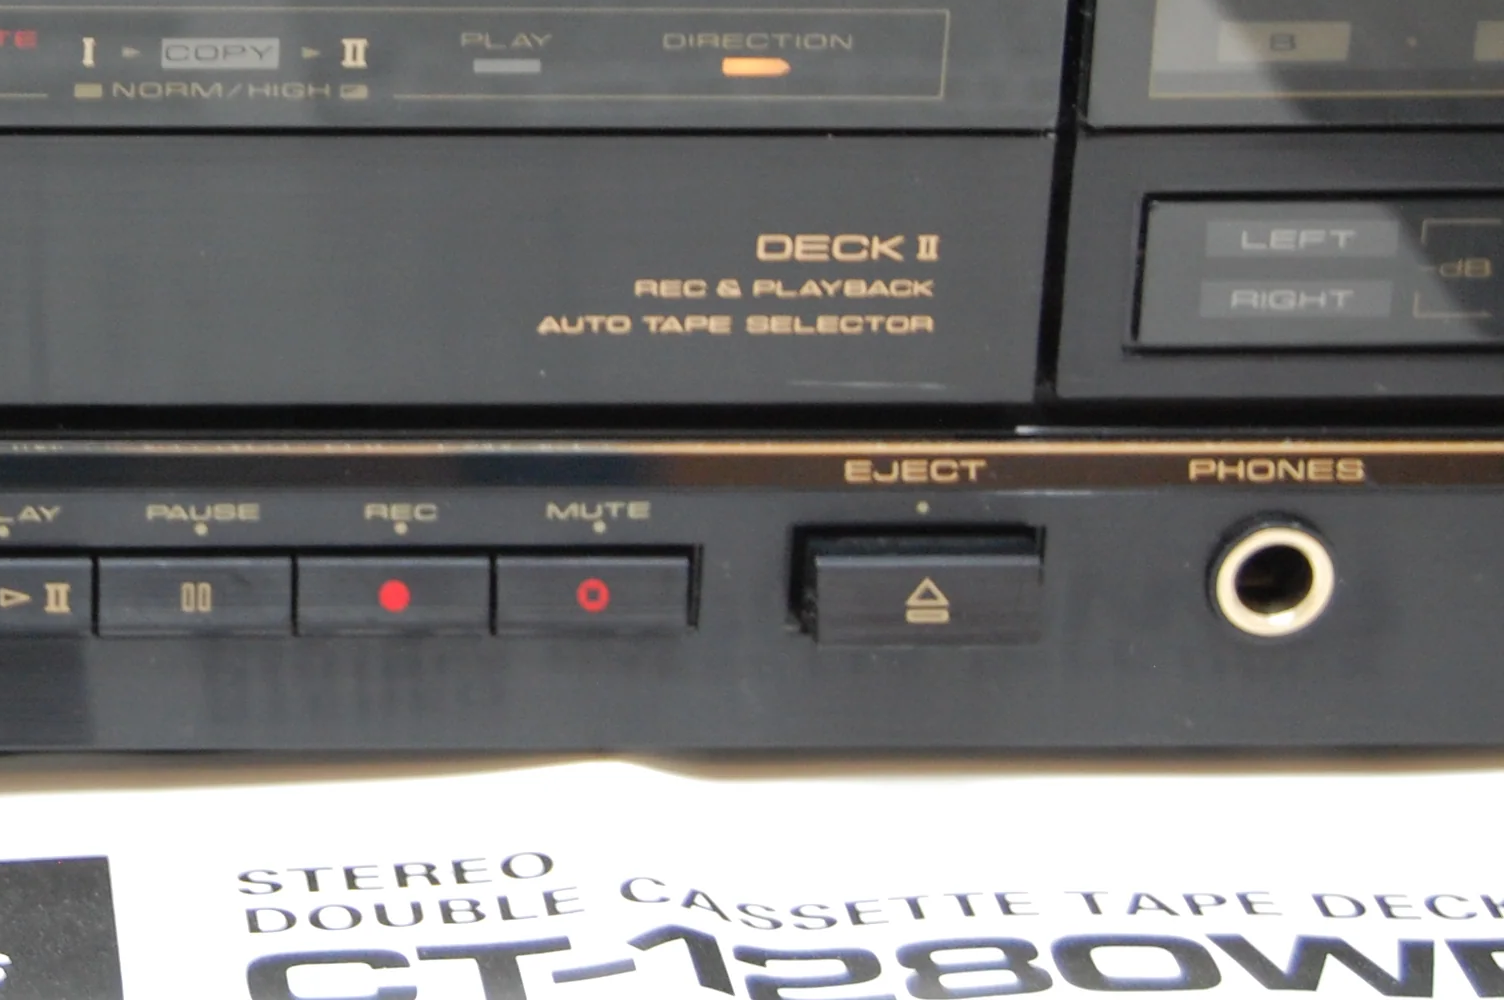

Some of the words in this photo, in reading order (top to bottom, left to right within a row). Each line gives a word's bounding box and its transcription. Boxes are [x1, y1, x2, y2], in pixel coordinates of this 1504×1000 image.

[460, 32, 553, 50] PLAY
[662, 33, 854, 50] DIRECTION
[164, 44, 274, 62] COPY
[112, 81, 331, 99] NORM/HIGH
[756, 233, 905, 262] DECK
[1241, 230, 1356, 250] LEFT
[635, 279, 707, 298] REC
[716, 280, 742, 298] &
[753, 279, 935, 298] PLAYBACK
[1231, 290, 1355, 310] RIGHT
[537, 315, 632, 335] AUTO
[642, 315, 733, 335] TAPE
[745, 315, 935, 335] SELECTOR
[843, 460, 988, 483] EJECT
[1188, 459, 1365, 483] PHONES
[145, 503, 260, 522] PAUSE
[364, 503, 439, 522] REC
[545, 502, 652, 521] MUTE
[237, 852, 555, 895] STEREO
[246, 886, 586, 934] DOUBLE
[619, 877, 1040, 931] CASSETTE
[1063, 891, 1285, 917] TAPE
